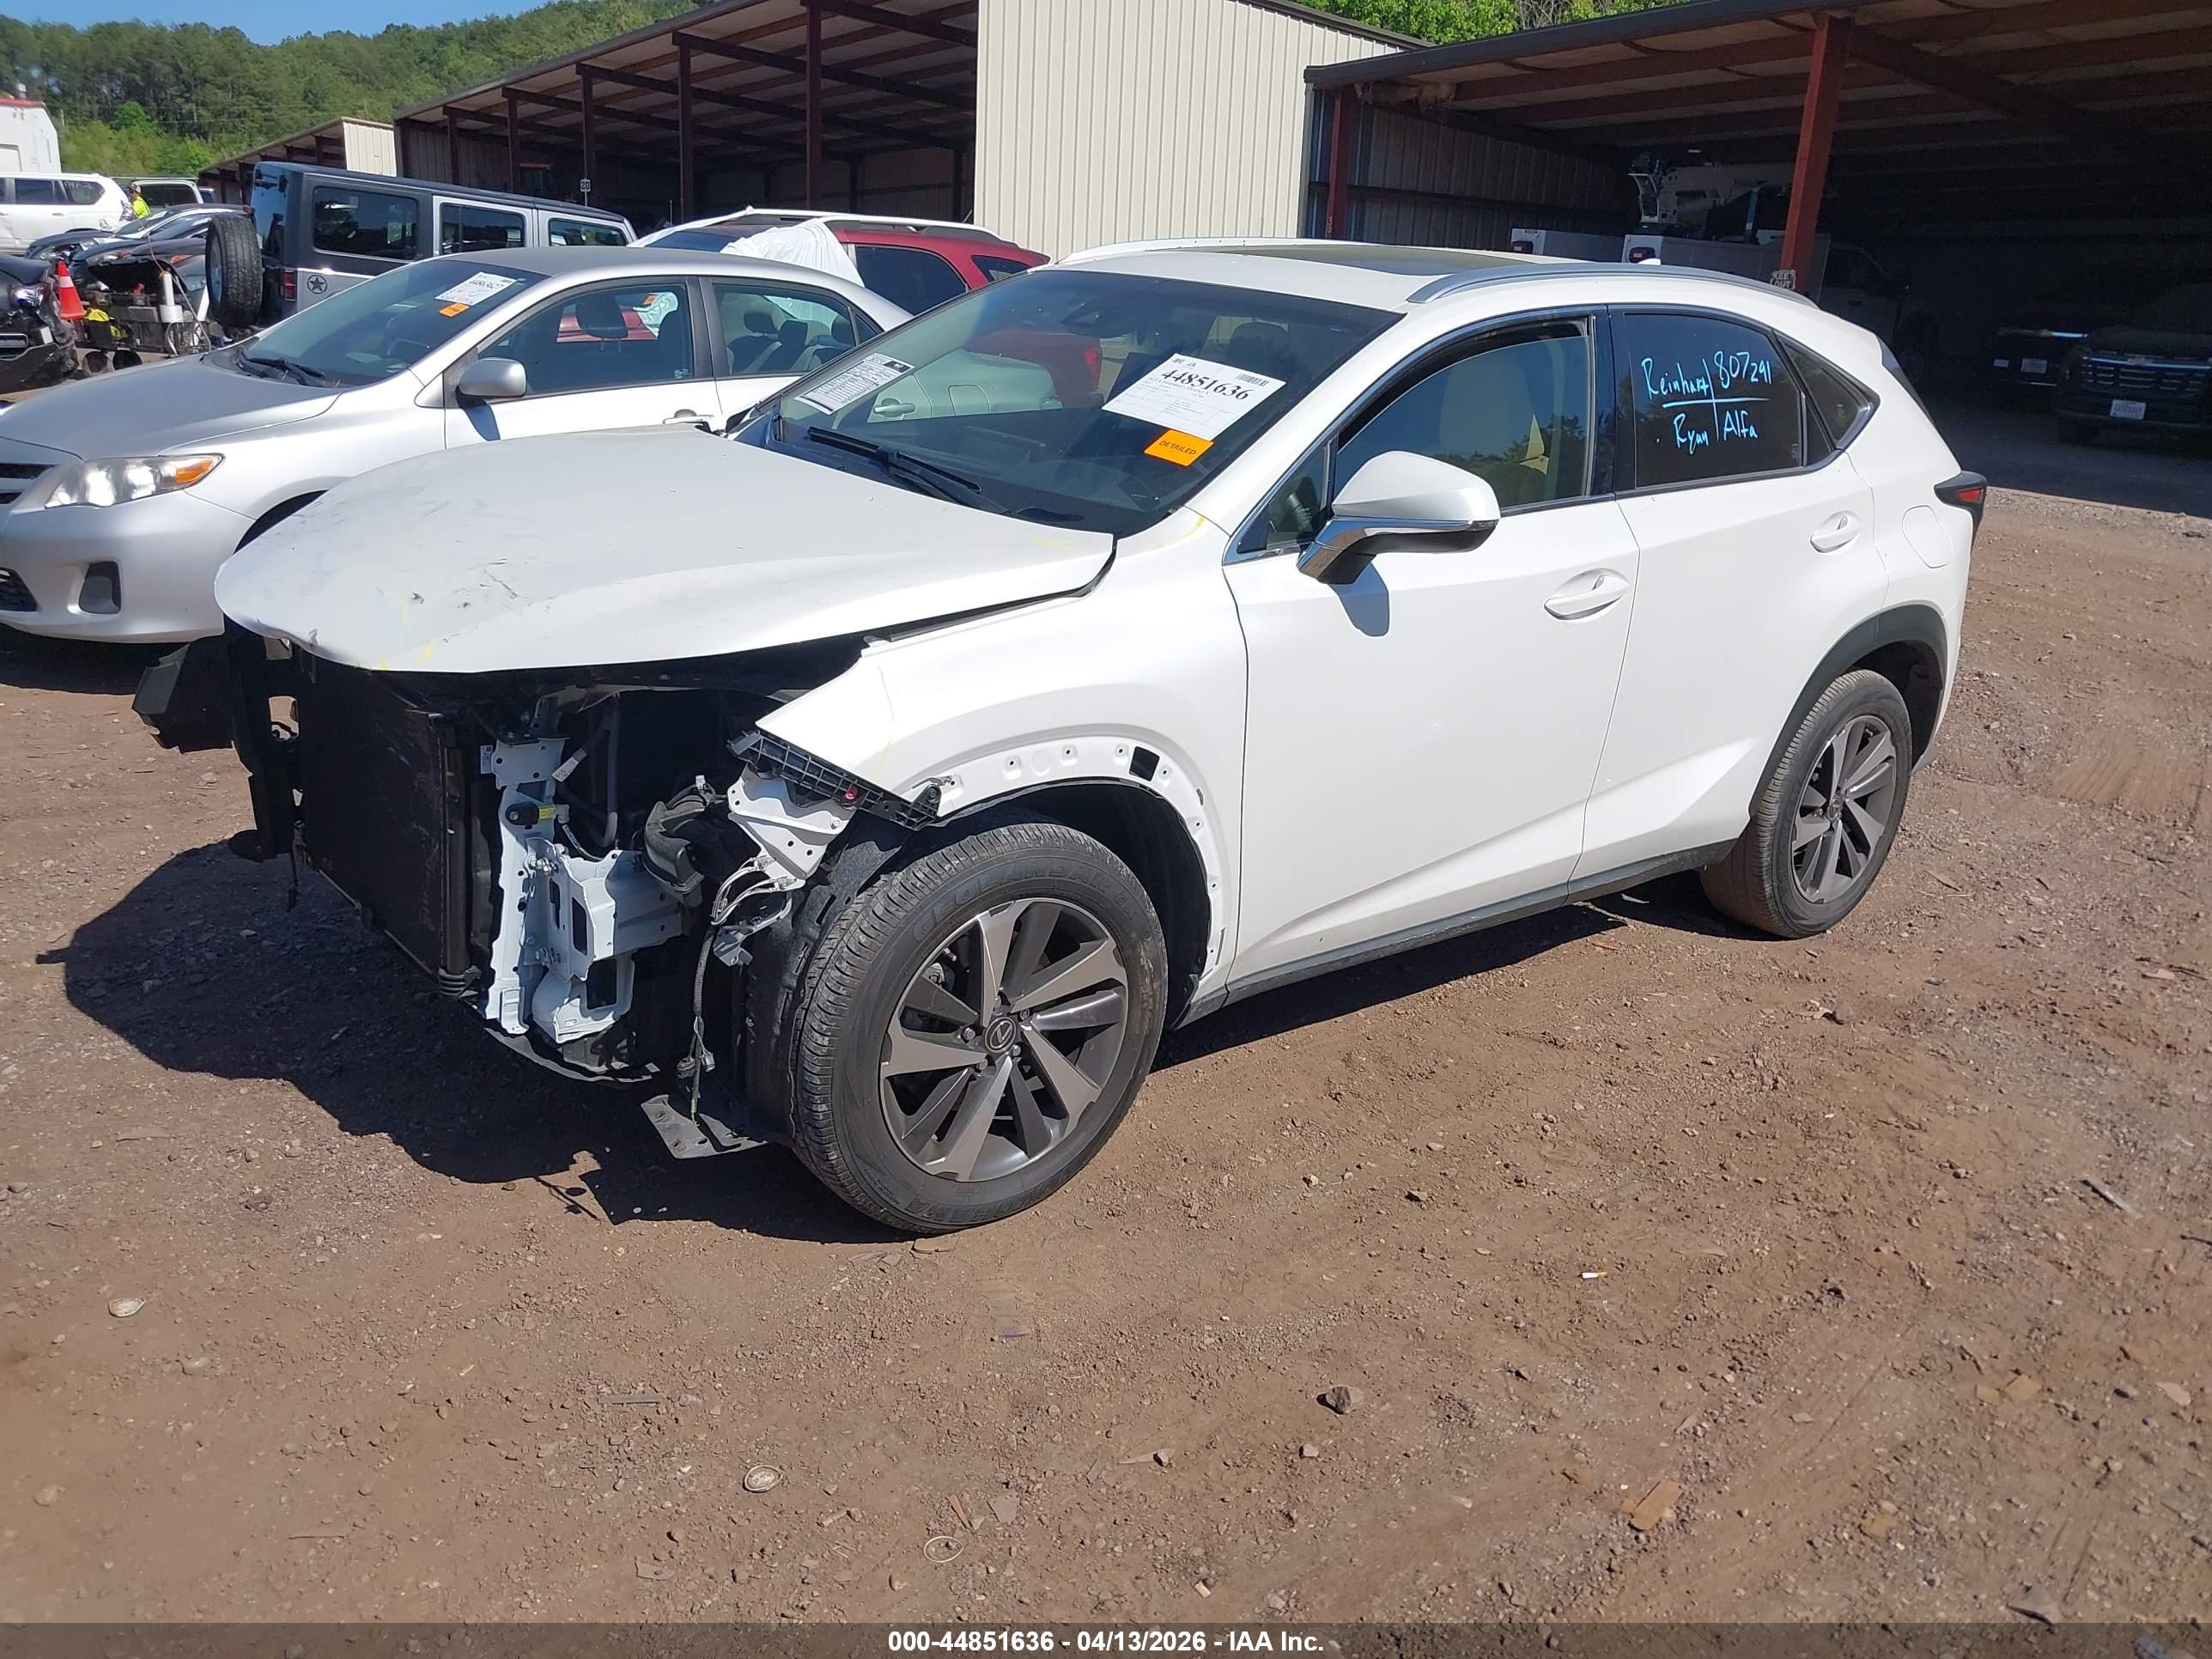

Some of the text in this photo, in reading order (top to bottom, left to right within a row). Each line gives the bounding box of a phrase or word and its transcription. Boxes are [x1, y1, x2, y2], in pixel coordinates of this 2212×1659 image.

[580, 181, 590, 190] 20
[1161, 369, 1251, 400] 44851636
[1713, 350, 1772, 389] 807291
[1673, 409, 1758, 455] Ryan Alfa
[1159, 441, 1196, 456] DETAILED
